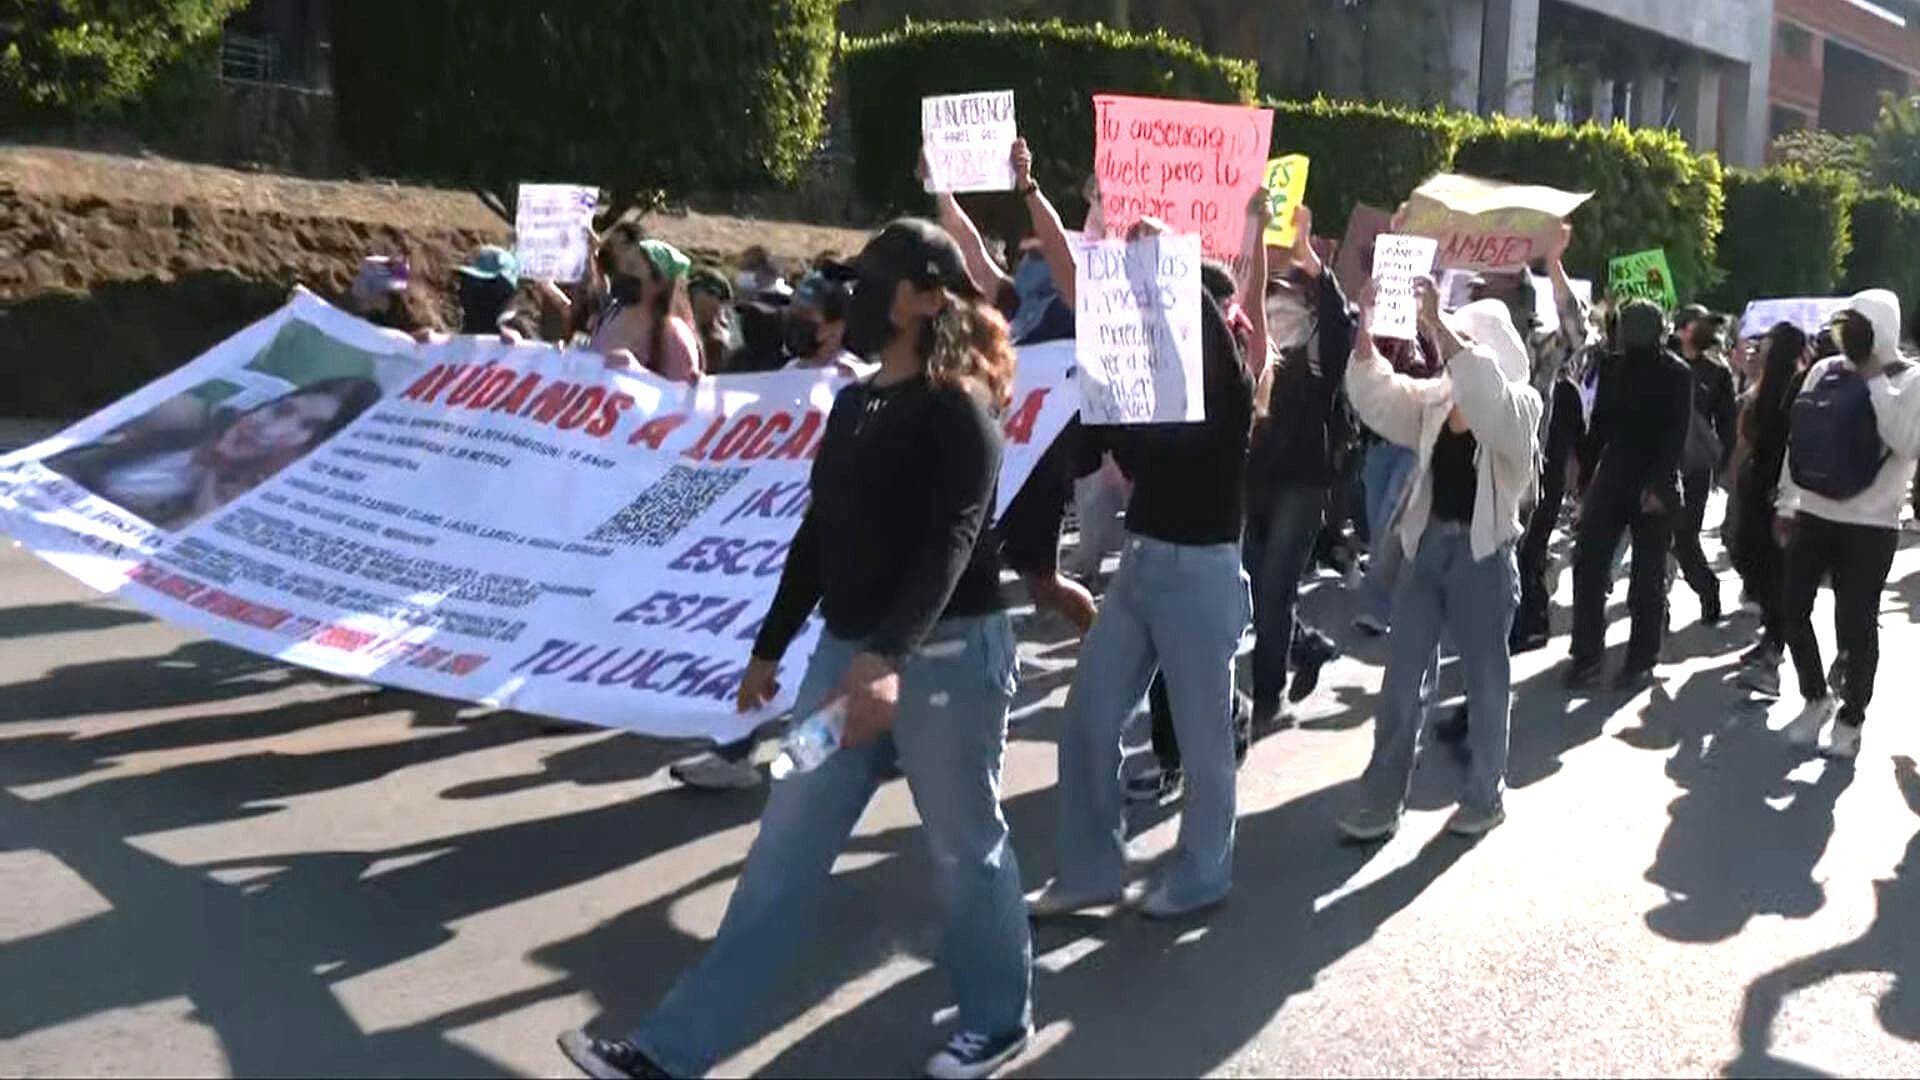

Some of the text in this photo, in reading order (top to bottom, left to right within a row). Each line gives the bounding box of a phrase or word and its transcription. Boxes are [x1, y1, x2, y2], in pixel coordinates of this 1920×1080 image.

[1097, 100, 1120, 142] Tu
[1161, 160, 1203, 193] pero
[401, 359, 636, 438] AYÚDANOS
[627, 412, 697, 450] A
[612, 590, 752, 636] ESTA
[510, 638, 598, 676] TU
